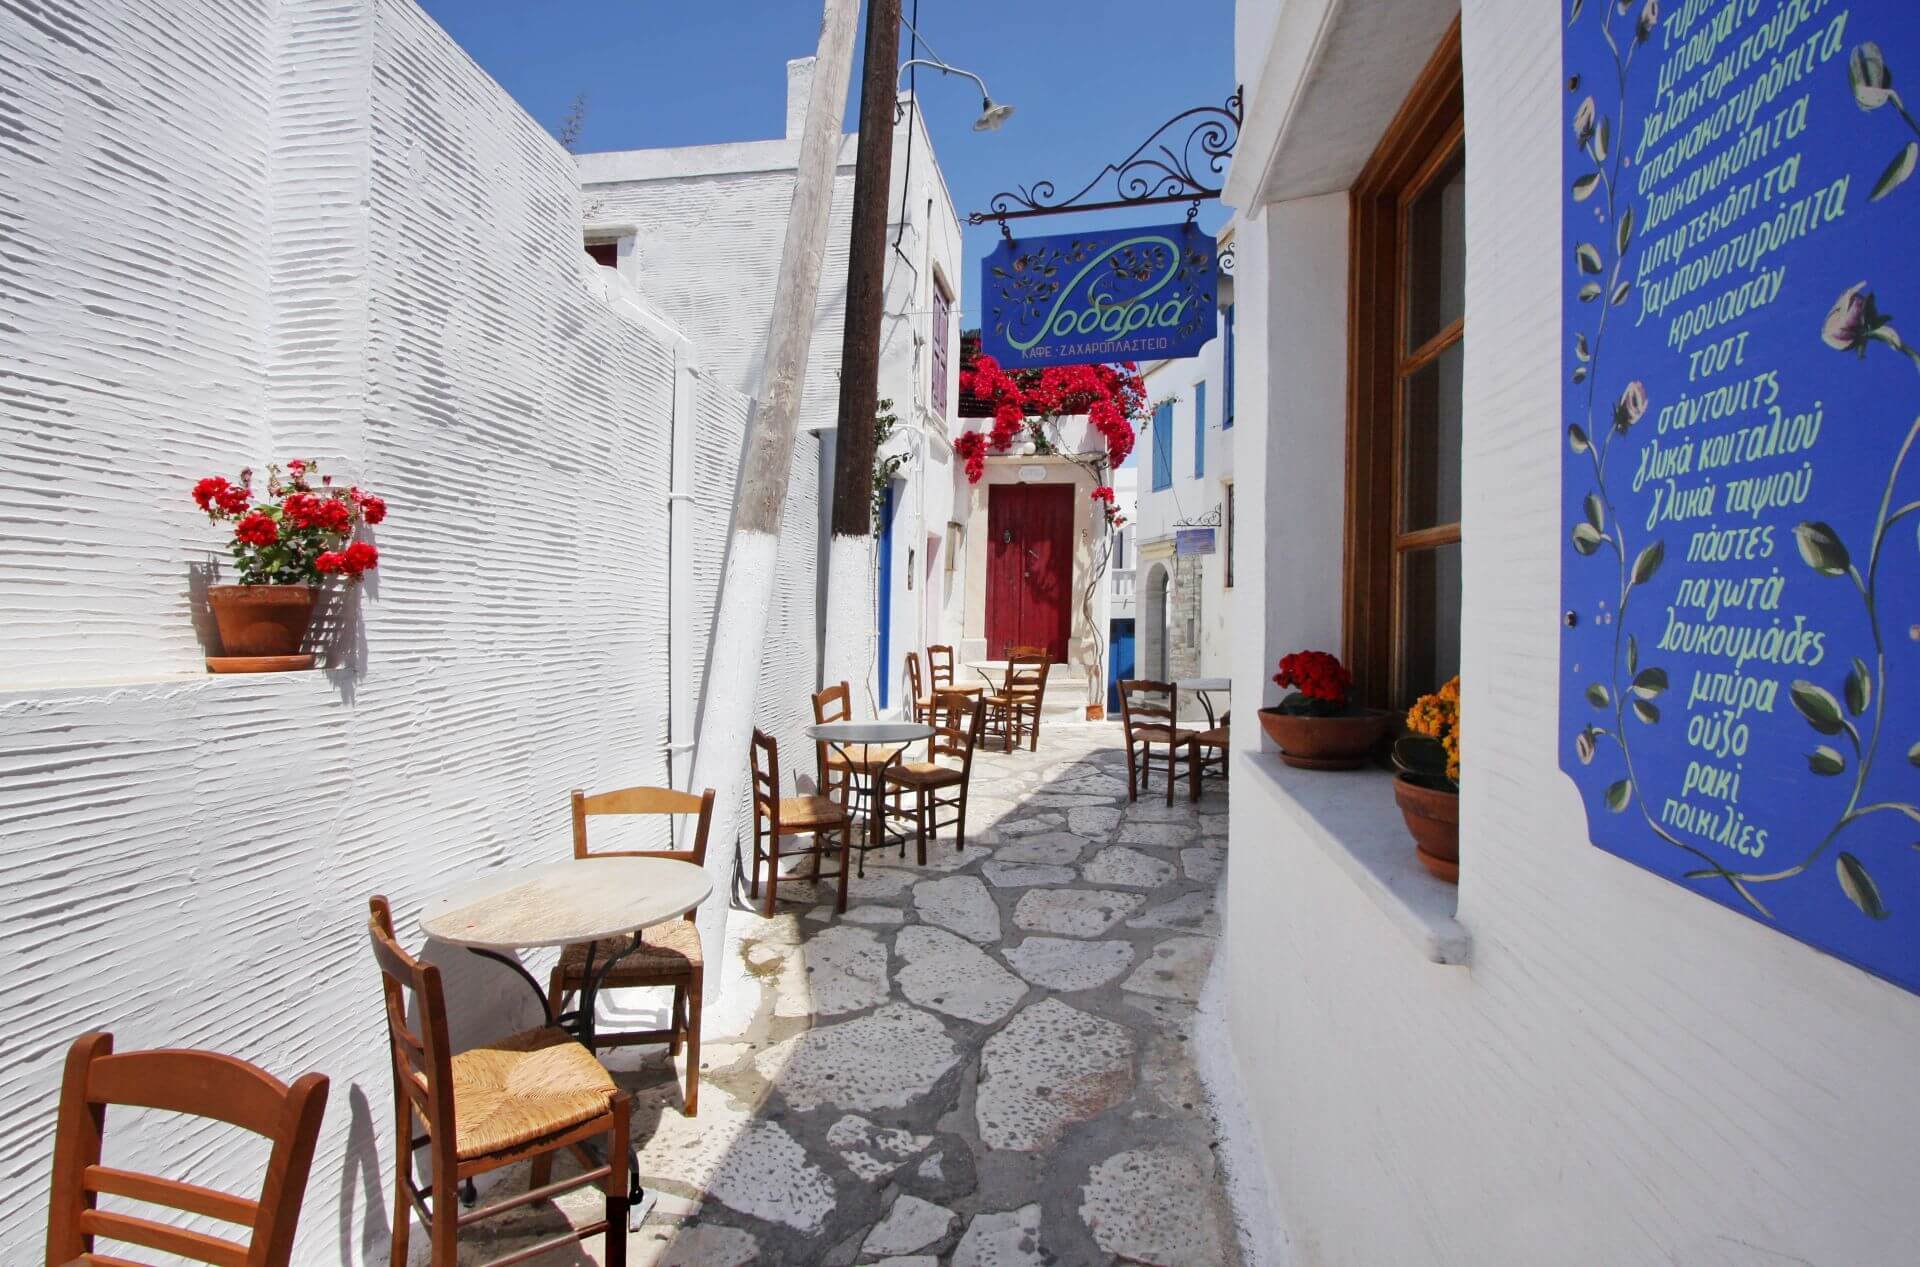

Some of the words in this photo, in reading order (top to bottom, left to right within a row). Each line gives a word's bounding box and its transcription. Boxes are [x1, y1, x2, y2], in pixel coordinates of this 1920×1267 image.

[1638, 9, 1849, 196] σπανακοτυρόπιτα
[1640, 94, 1810, 238] λουκανικόπιτα
[1635, 152, 1802, 288] μπιφτεκόπιτα
[1635, 174, 1850, 328] ζαμπονοτυρόπιτα
[1667, 265, 1786, 353] κρουασάν
[1688, 331, 1749, 382] τοστ
[1657, 369, 1780, 435] σάντουιτς
[1632, 435, 1694, 493] γλυκά
[1697, 400, 1823, 472] κουταλιού
[1646, 477, 1716, 532] γλυκά
[1726, 461, 1812, 520] ταψιού
[1686, 523, 1776, 563] πάστες
[1675, 566, 1786, 622] παγωτά
[1656, 606, 1826, 668] λουκουμάδες
[1687, 669, 1779, 719] μπύρα
[1687, 710, 1749, 759] ούζο
[1681, 760, 1743, 804] ρακί
[1661, 798, 1768, 859] ποικιλίες
